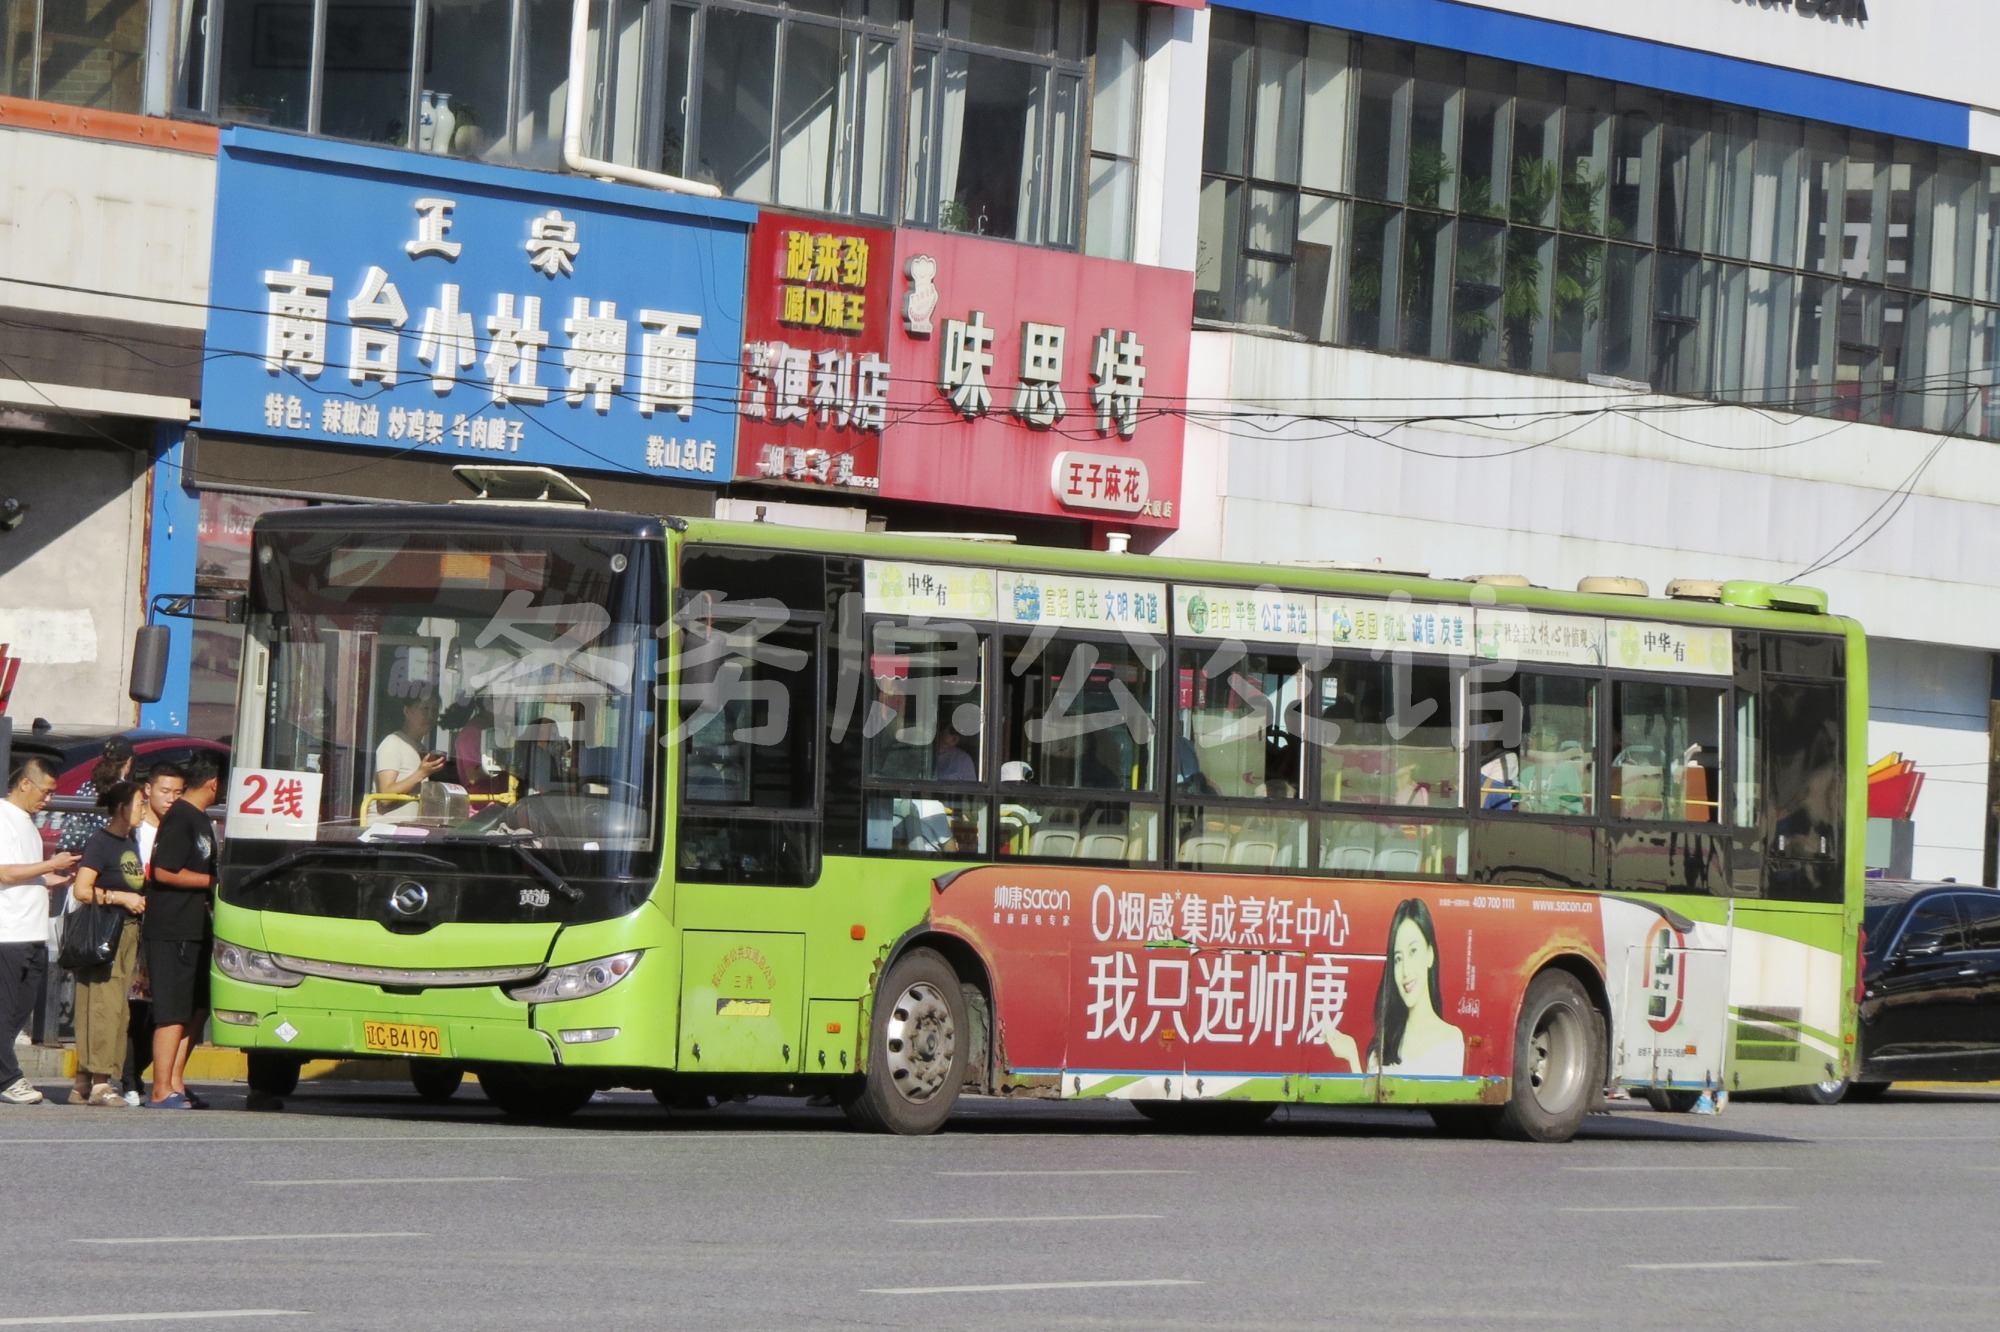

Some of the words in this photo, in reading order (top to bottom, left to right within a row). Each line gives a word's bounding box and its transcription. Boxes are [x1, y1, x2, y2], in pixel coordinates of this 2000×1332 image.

[406, 198, 580, 276] 正宗
[784, 286, 866, 331] 嚼口味王
[264, 259, 702, 418] 南台小杜抻面
[774, 343, 890, 430] 便利店
[940, 311, 1147, 438] 味思特
[322, 399, 380, 437] 辣椒油
[388, 406, 443, 444] 炒鸡架
[645, 435, 716, 473] 鞍山总店
[1067, 463, 1140, 503] 王子麻花
[1046, 585, 1069, 618] 富强
[1076, 588, 1098, 619] 民主
[1105, 590, 1128, 621] 文明
[1134, 592, 1157, 624] 和谐
[1211, 600, 1231, 629] 自由
[1236, 600, 1256, 631] 平等
[1261, 602, 1281, 632] 公正
[1287, 603, 1307, 634] 法治
[1355, 609, 1378, 640] 爱国
[1384, 612, 1407, 642] 敬业
[1412, 614, 1435, 644] 诚信
[1441, 615, 1464, 646] 友善
[1504, 620, 1588, 649] 社会主义核心价值观
[240, 774, 303, 819] 2线
[519, 889, 550, 907] 黄海
[1532, 900, 1593, 913] www.sacon.cn
[734, 975, 753, 990] 三汽
[1086, 951, 1349, 1046] 我只选帅康
